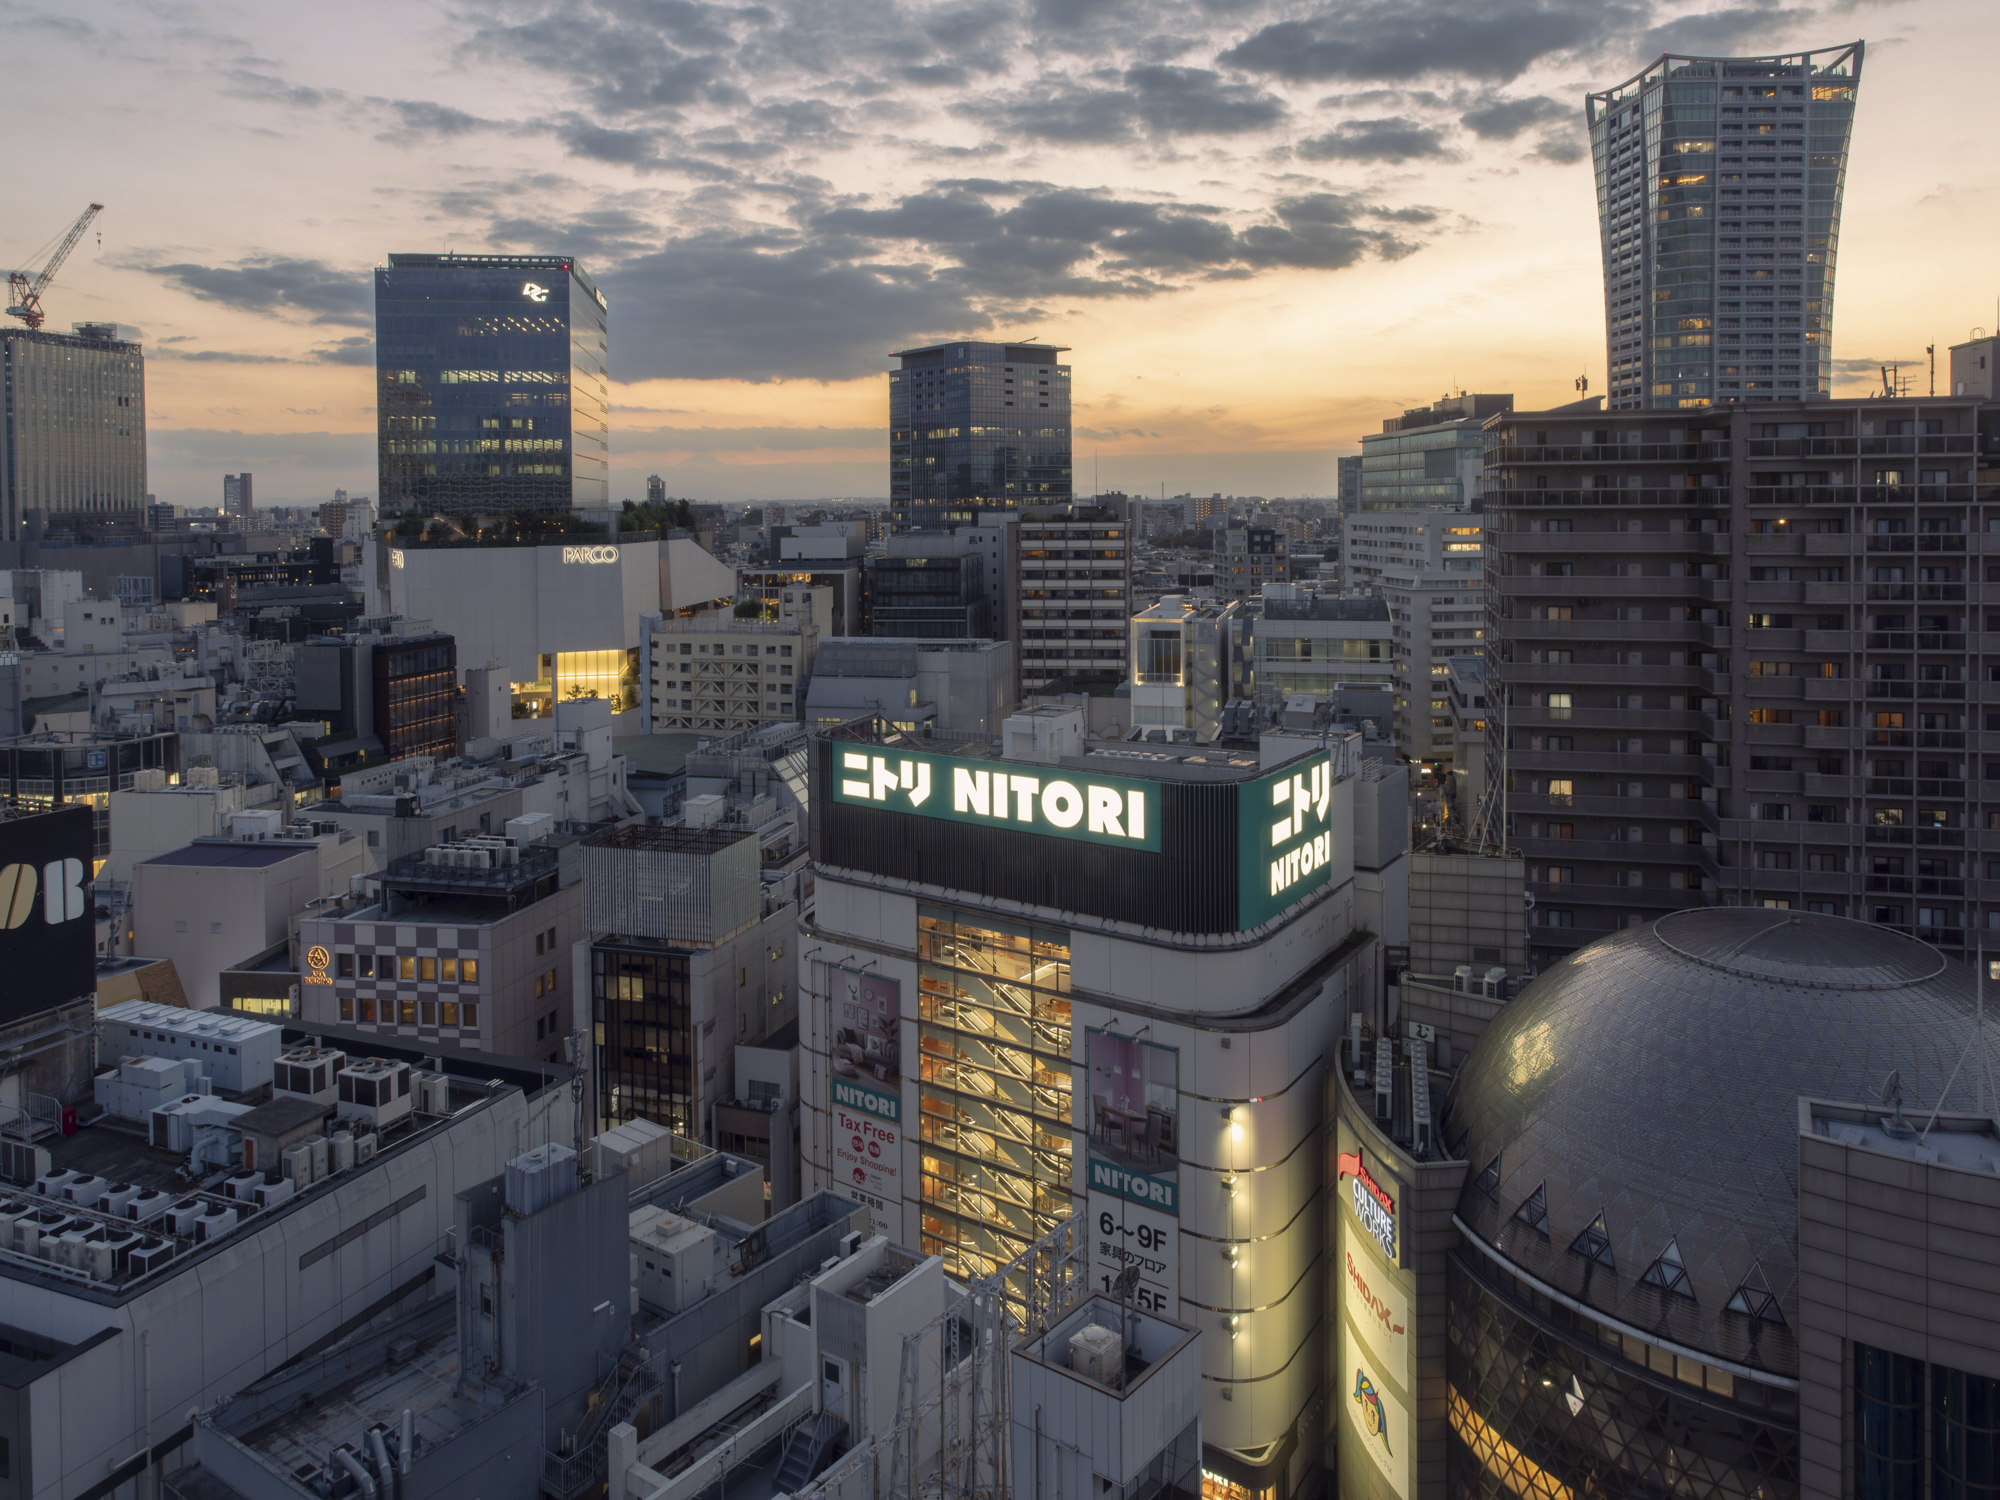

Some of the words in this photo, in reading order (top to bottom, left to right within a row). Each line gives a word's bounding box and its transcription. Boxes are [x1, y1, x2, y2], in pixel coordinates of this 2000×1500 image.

[563, 547, 618, 564] PARCO
[843, 752, 931, 808] ニトリ
[953, 768, 1145, 839] NITORI
[1271, 760, 1330, 846] ニトリ
[1270, 830, 1330, 896] NITORI
[311, 970, 326, 978] ASIA
[1416, 1023, 1430, 1039] む
[836, 1083, 896, 1118] NITORI
[838, 1112, 861, 1133] Tax
[863, 1121, 895, 1144] Free
[837, 1148, 858, 1163] Enjoy
[860, 1156, 897, 1177] Shopping!
[1094, 1164, 1172, 1206] NITORI
[1360, 1166, 1394, 1215] SHIDAX
[1352, 1178, 1392, 1240] CULTURE
[1353, 1195, 1393, 1259] WORKS
[1099, 1241, 1167, 1274] 家具のフロア
[1101, 1274, 1167, 1313] 15F
[1347, 1251, 1392, 1333] SHIDAX
